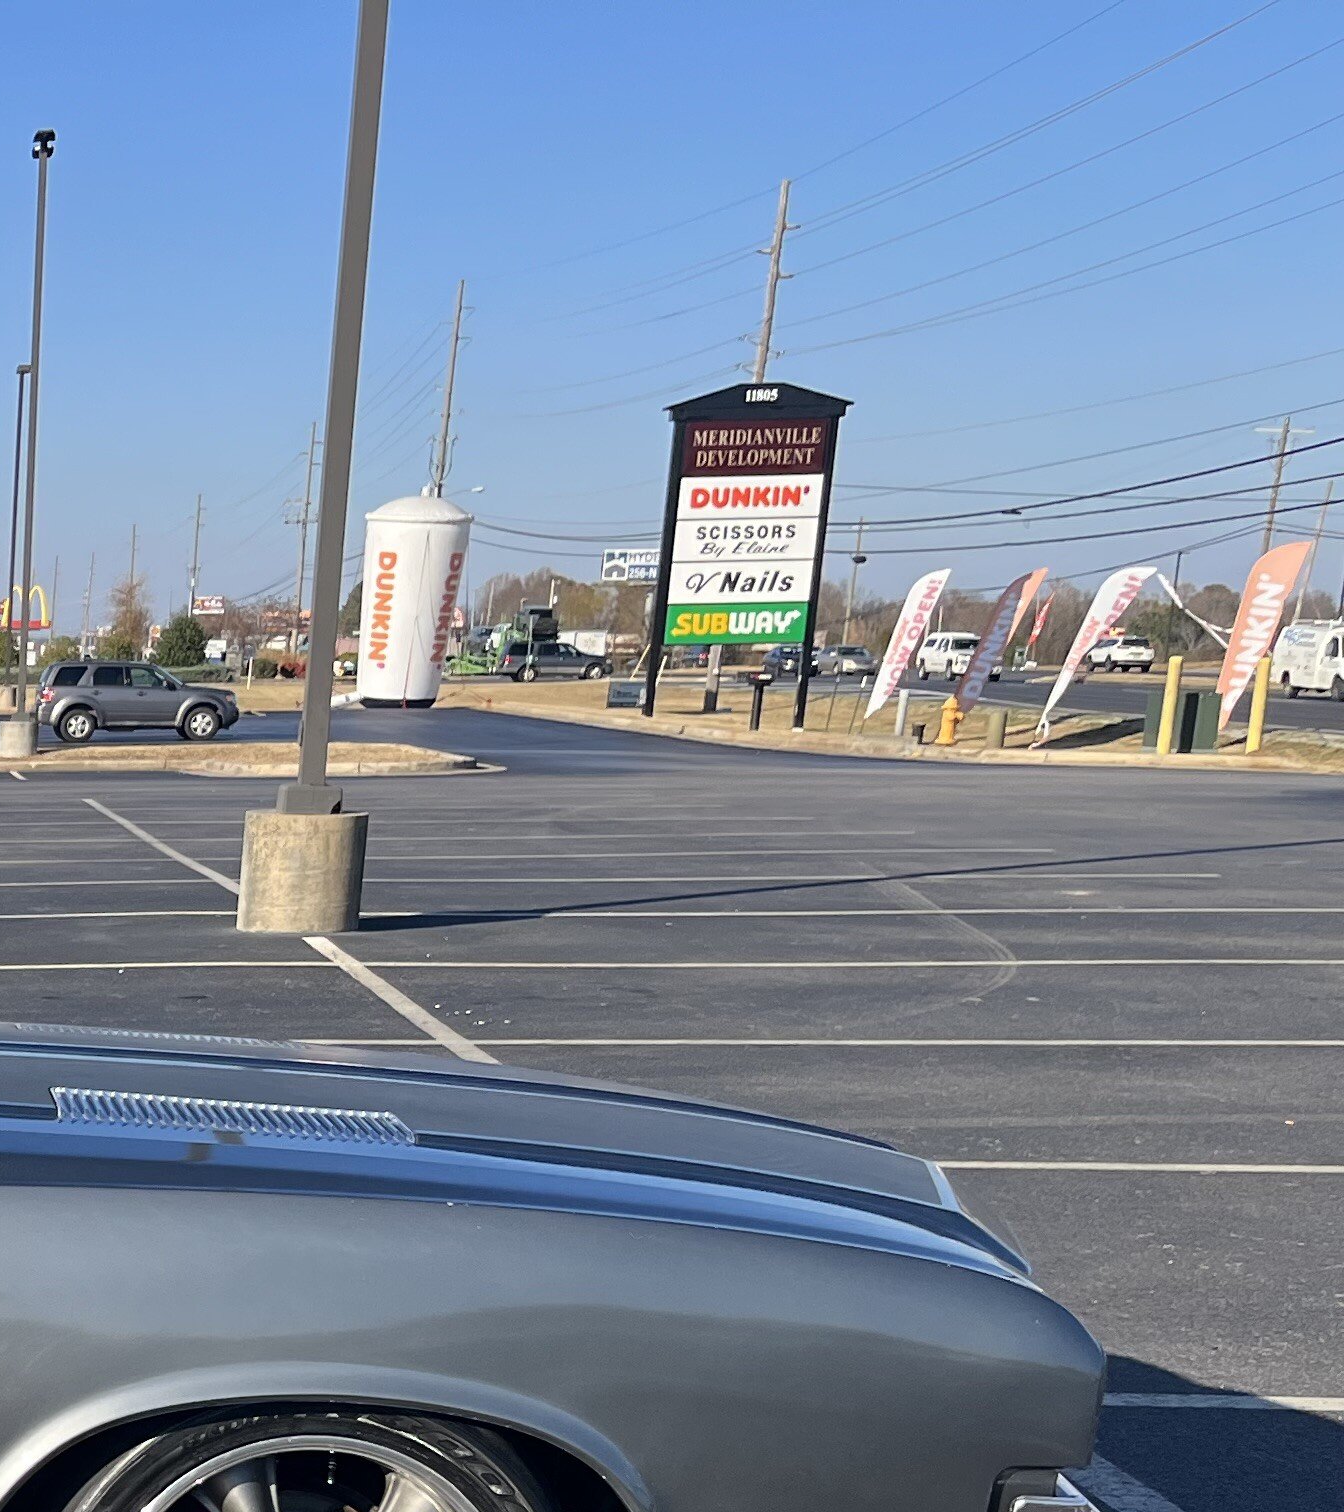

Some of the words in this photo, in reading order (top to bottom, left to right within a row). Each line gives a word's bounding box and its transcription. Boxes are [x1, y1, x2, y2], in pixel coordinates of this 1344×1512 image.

[745, 388, 779, 403] 11805
[693, 427, 822, 447] MERIDIANVILLE
[696, 448, 815, 467] DEVELOPMENT
[690, 486, 810, 509] DUNKIN'
[696, 525, 797, 540] SCISSORS
[700, 542, 726, 557] By
[732, 541, 790, 554] Elaine
[719, 571, 795, 593] Nails
[671, 610, 802, 636] SUBWAY
